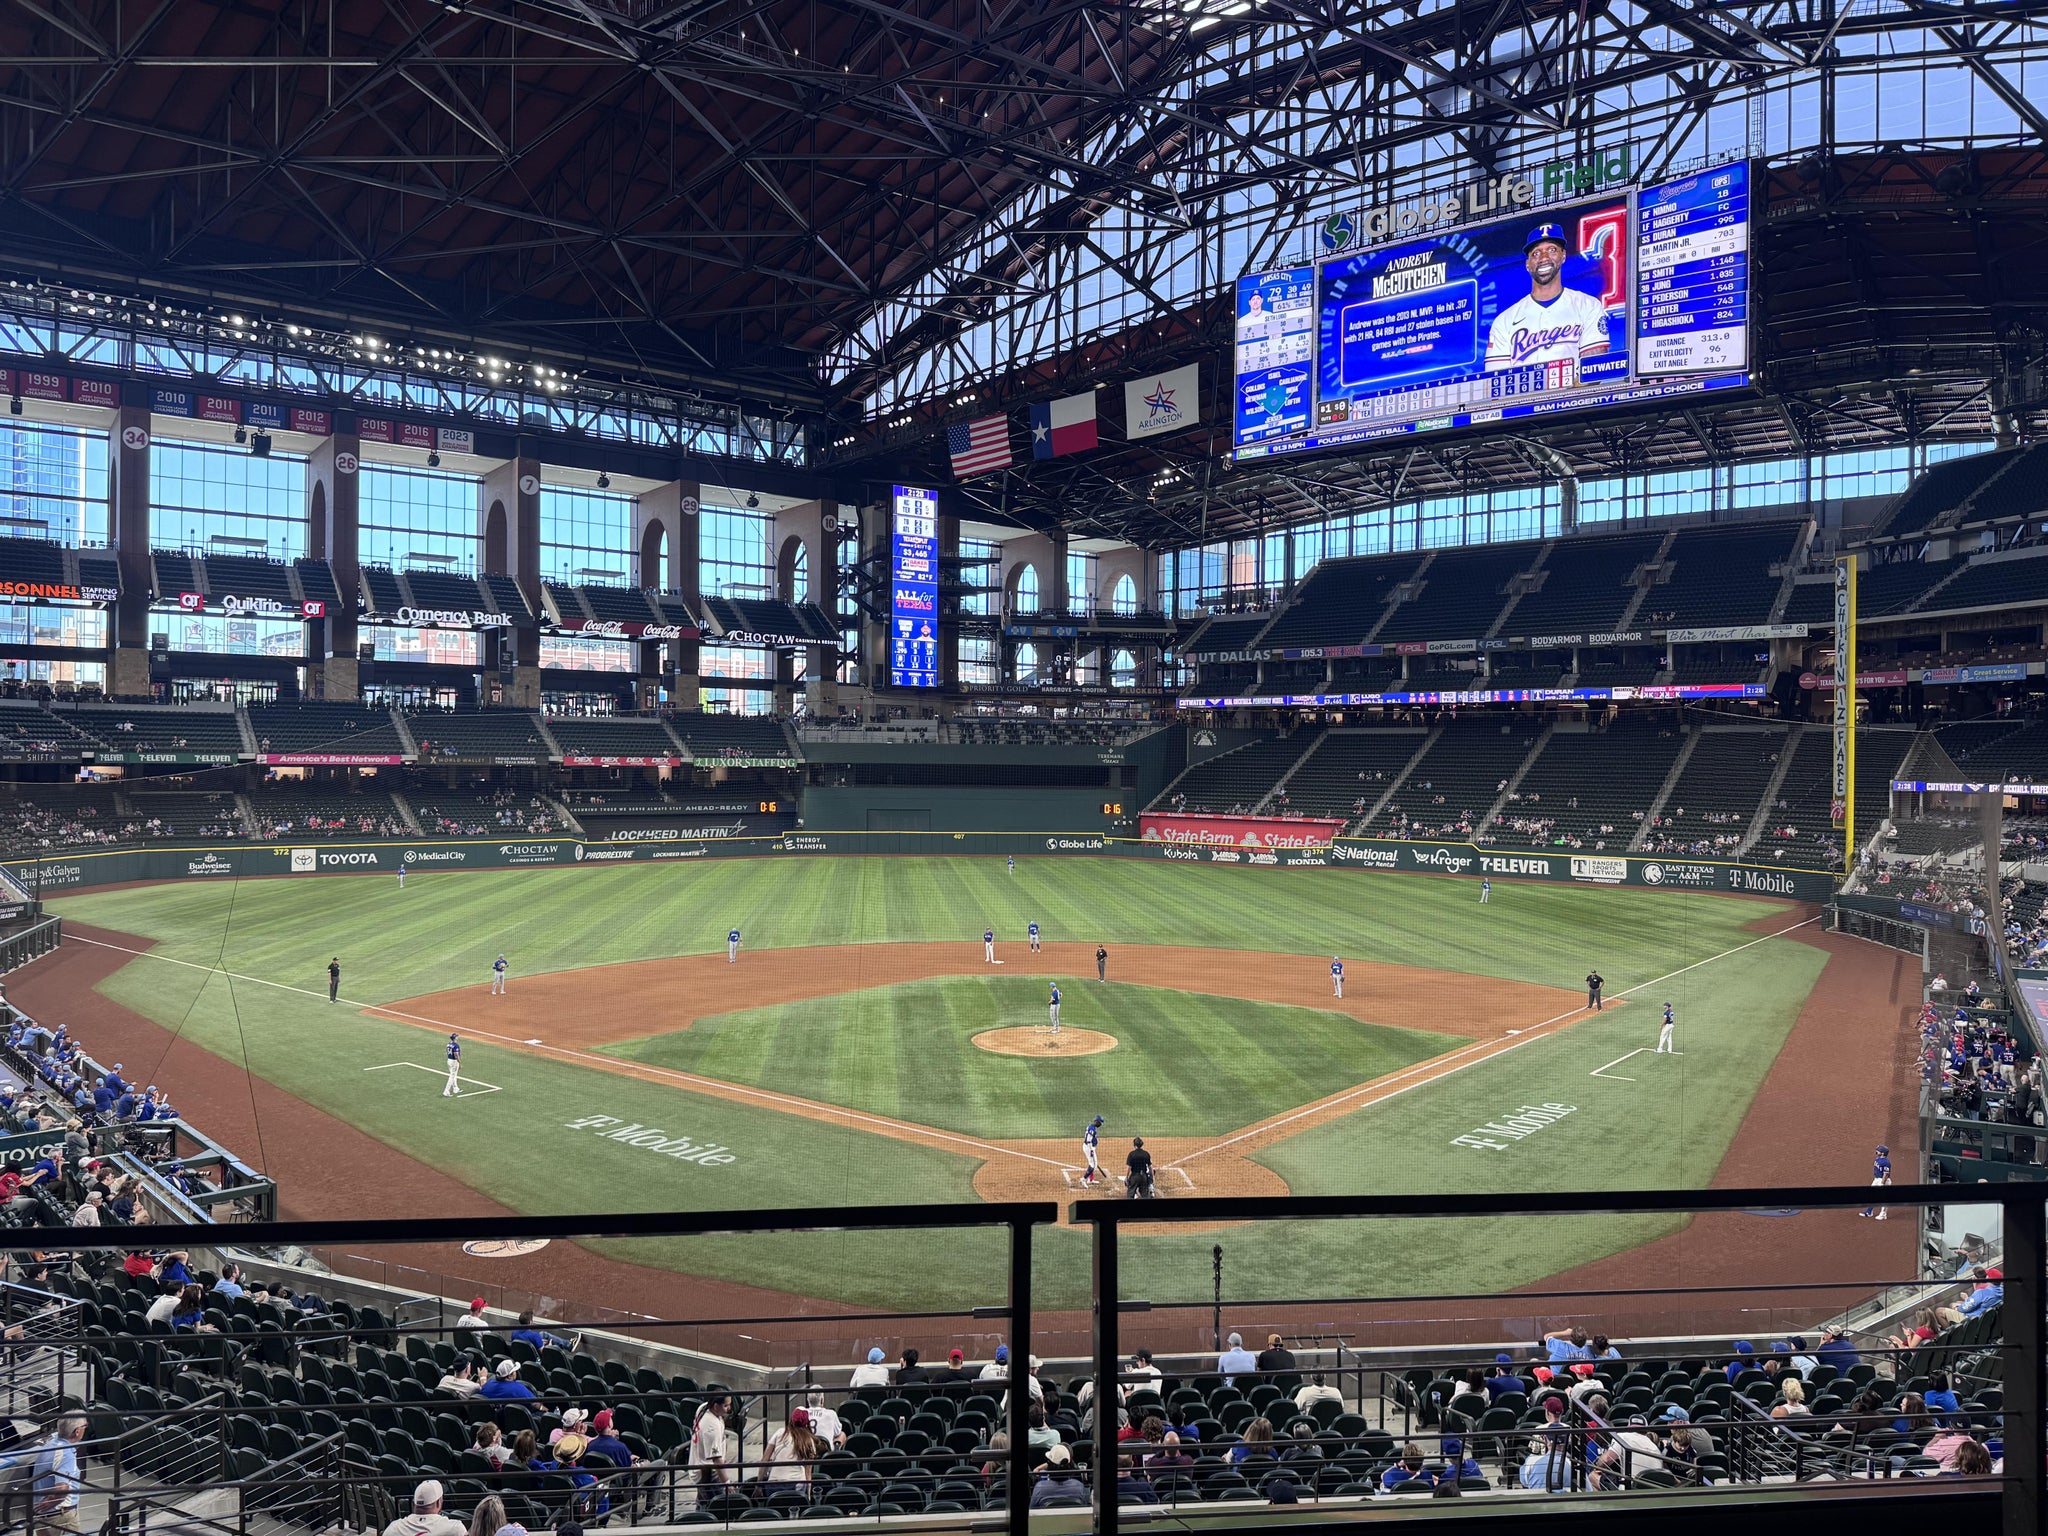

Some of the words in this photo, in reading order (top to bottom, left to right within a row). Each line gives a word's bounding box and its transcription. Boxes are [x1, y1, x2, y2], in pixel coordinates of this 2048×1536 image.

[1364, 197, 1461, 238] Globe
[1469, 173, 1533, 215] Life
[1543, 145, 1628, 197] Field
[1653, 212, 1689, 229] HAGGERTY
[1653, 228, 1676, 242] DURAN
[1385, 251, 1433, 273] ANDREW
[1652, 266, 1675, 279] SMITH
[1372, 262, 1446, 299] McCUTCHEN
[1652, 280, 1671, 291] JUNG
[1652, 289, 1689, 304] PEDERSON
[1349, 319, 1371, 331] Andrew
[1373, 317, 1385, 327] was
[1385, 314, 1396, 325] the
[1436, 303, 1445, 314] He
[1445, 301, 1455, 312] hit
[1455, 298, 1467, 310] .317
[1652, 304, 1679, 316] CARTER
[1344, 332, 1357, 343] with
[1395, 323, 1407, 334] and
[1415, 318, 1435, 331] stolen
[1435, 315, 1454, 327] bases
[1462, 310, 1472, 322] 157
[1651, 314, 1695, 329] HIGASHIOKA
[1372, 340, 1392, 353] games
[1392, 335, 1405, 347] with
[1407, 334, 1417, 345] the
[1417, 331, 1442, 344] Pirates.
[1656, 337, 1686, 348] DISTANCE
[1649, 350, 1662, 360] EXIT
[1663, 347, 1693, 358] VELOCITY
[1581, 358, 1627, 375] CUTWATER
[1654, 360, 1667, 370] EXIT
[1668, 358, 1688, 368] ANGLE
[1704, 355, 1727, 365] 21.7
[27, 373, 60, 388] 1999
[81, 380, 112, 395] 2010
[24, 389, 62, 399] CHAMPIONS
[156, 390, 186, 405] 2010
[78, 396, 115, 407] CHAMPIONS
[206, 397, 233, 412] 2011
[153, 406, 188, 416] CHAMPIONS
[252, 403, 277, 417] 2011
[202, 413, 237, 423] CHAMPIONS
[298, 410, 324, 423] 2012
[1138, 411, 1183, 430] ARLINGTON
[1272, 444, 1288, 453] 91.3
[1288, 441, 1306, 451] MPH
[1317, 433, 1364, 446] FOUR-SEAM
[1364, 426, 1408, 440] FASTBALL
[1472, 413, 1490, 421] LAST
[1533, 403, 1557, 413] SAM
[1557, 395, 1611, 410] HAGGERTY
[1612, 388, 1663, 401] FIELDER'S
[1664, 381, 1705, 394] CHOICE
[362, 418, 387, 431] 2015
[404, 424, 429, 437] 2016
[125, 430, 145, 445] 34
[442, 429, 468, 442] 2023
[338, 457, 355, 469] 26
[525, 479, 533, 491] 7
[683, 499, 697, 511] 29
[825, 518, 834, 529] 10
[81, 586, 118, 597] STAFFING
[81, 593, 117, 602] SERVICES
[896, 589, 919, 601] ALL
[916, 591, 934, 606] for
[181, 594, 201, 608] QT
[223, 594, 283, 613] QuikTrip
[895, 599, 933, 611] TEXAS
[304, 602, 323, 616] QT
[473, 611, 512, 626] Bank
[583, 618, 625, 636] Coca-Cola
[642, 622, 683, 639] Coca-Cola
[1589, 632, 1642, 643] BODYARMOR
[1668, 629, 1697, 641] Blue
[1701, 628, 1733, 640] Mint
[1739, 626, 1768, 640] Thai
[1836, 592, 1846, 683] CHIKIN
[1531, 634, 1582, 646] BODYARMOR
[1300, 648, 1323, 658] 105.3
[1325, 647, 1341, 657] THE
[1343, 646, 1362, 656] FAN
[1403, 643, 1425, 652] PGL
[1428, 641, 1474, 652] GoPGL.com
[1198, 651, 1218, 663] UT
[1220, 649, 1271, 662] DALLAS
[1973, 669, 1992, 678] Great
[1993, 667, 2018, 677] Service
[1873, 676, 1885, 685] YOU
[969, 684, 1006, 694] PRIORITY
[1008, 684, 1029, 693] GOLD
[1041, 686, 1072, 694] HARGROVE
[1082, 687, 1108, 695] ROOFING
[1120, 687, 1163, 695] PLUCKERS
[1746, 687, 1764, 695] 2:28
[99, 753, 124, 762] 7-ELEVEN
[138, 753, 177, 763] 7-ELEVEN
[194, 754, 231, 764] 7-ELEVEN
[279, 754, 326, 764] America's
[330, 754, 352, 764] Best
[353, 754, 391, 764] Network
[573, 756, 593, 764] DEX
[599, 756, 620, 764] DEX
[704, 757, 743, 768] LUXOR
[744, 757, 795, 769] STAFFING
[1836, 730, 1846, 795] FARE
[1926, 783, 1963, 792] CUTWATER
[760, 801, 777, 812] 0:16
[1104, 803, 1121, 814] 0:16
[611, 829, 678, 842] LOCKHEED
[681, 827, 729, 840] MARTIN
[796, 836, 821, 844] ENERGY
[1163, 827, 1198, 843] State
[1199, 829, 1235, 845] Farm
[506, 845, 558, 855] CHOCTAW
[772, 843, 783, 851] 410
[796, 843, 827, 851] TRANSFER
[1059, 839, 1085, 850] Globe
[1086, 839, 1103, 850] Life
[273, 848, 290, 857] 372
[418, 851, 449, 861] Medical
[450, 851, 466, 863] City
[584, 850, 635, 860] PROGRESSIVE
[653, 851, 683, 859] LOCKHEED
[684, 850, 703, 858] MARTIN
[1163, 848, 1199, 861] Kubota
[1312, 848, 1324, 856] 374
[1346, 847, 1399, 862] National
[320, 853, 378, 865] TOYOTA
[1287, 858, 1326, 866] HONDA
[1375, 861, 1395, 869] Rental
[1430, 849, 1473, 873] Kroger
[1591, 859, 1623, 868] RANGERS
[188, 862, 232, 871] Budweiser
[1480, 857, 1551, 876] 7-ELEVEN
[1665, 864, 1685, 873] EAST
[1686, 865, 1715, 875] TEXAS
[1591, 870, 1626, 878] NETWORK
[1678, 872, 1700, 881] A&M
[1664, 878, 1715, 888] UNIVERSITY
[1729, 869, 1743, 887] T
[1744, 871, 1796, 894] Mobile
[1472, 1102, 1577, 1141] Mobile
[594, 1123, 736, 1167] Mobile
